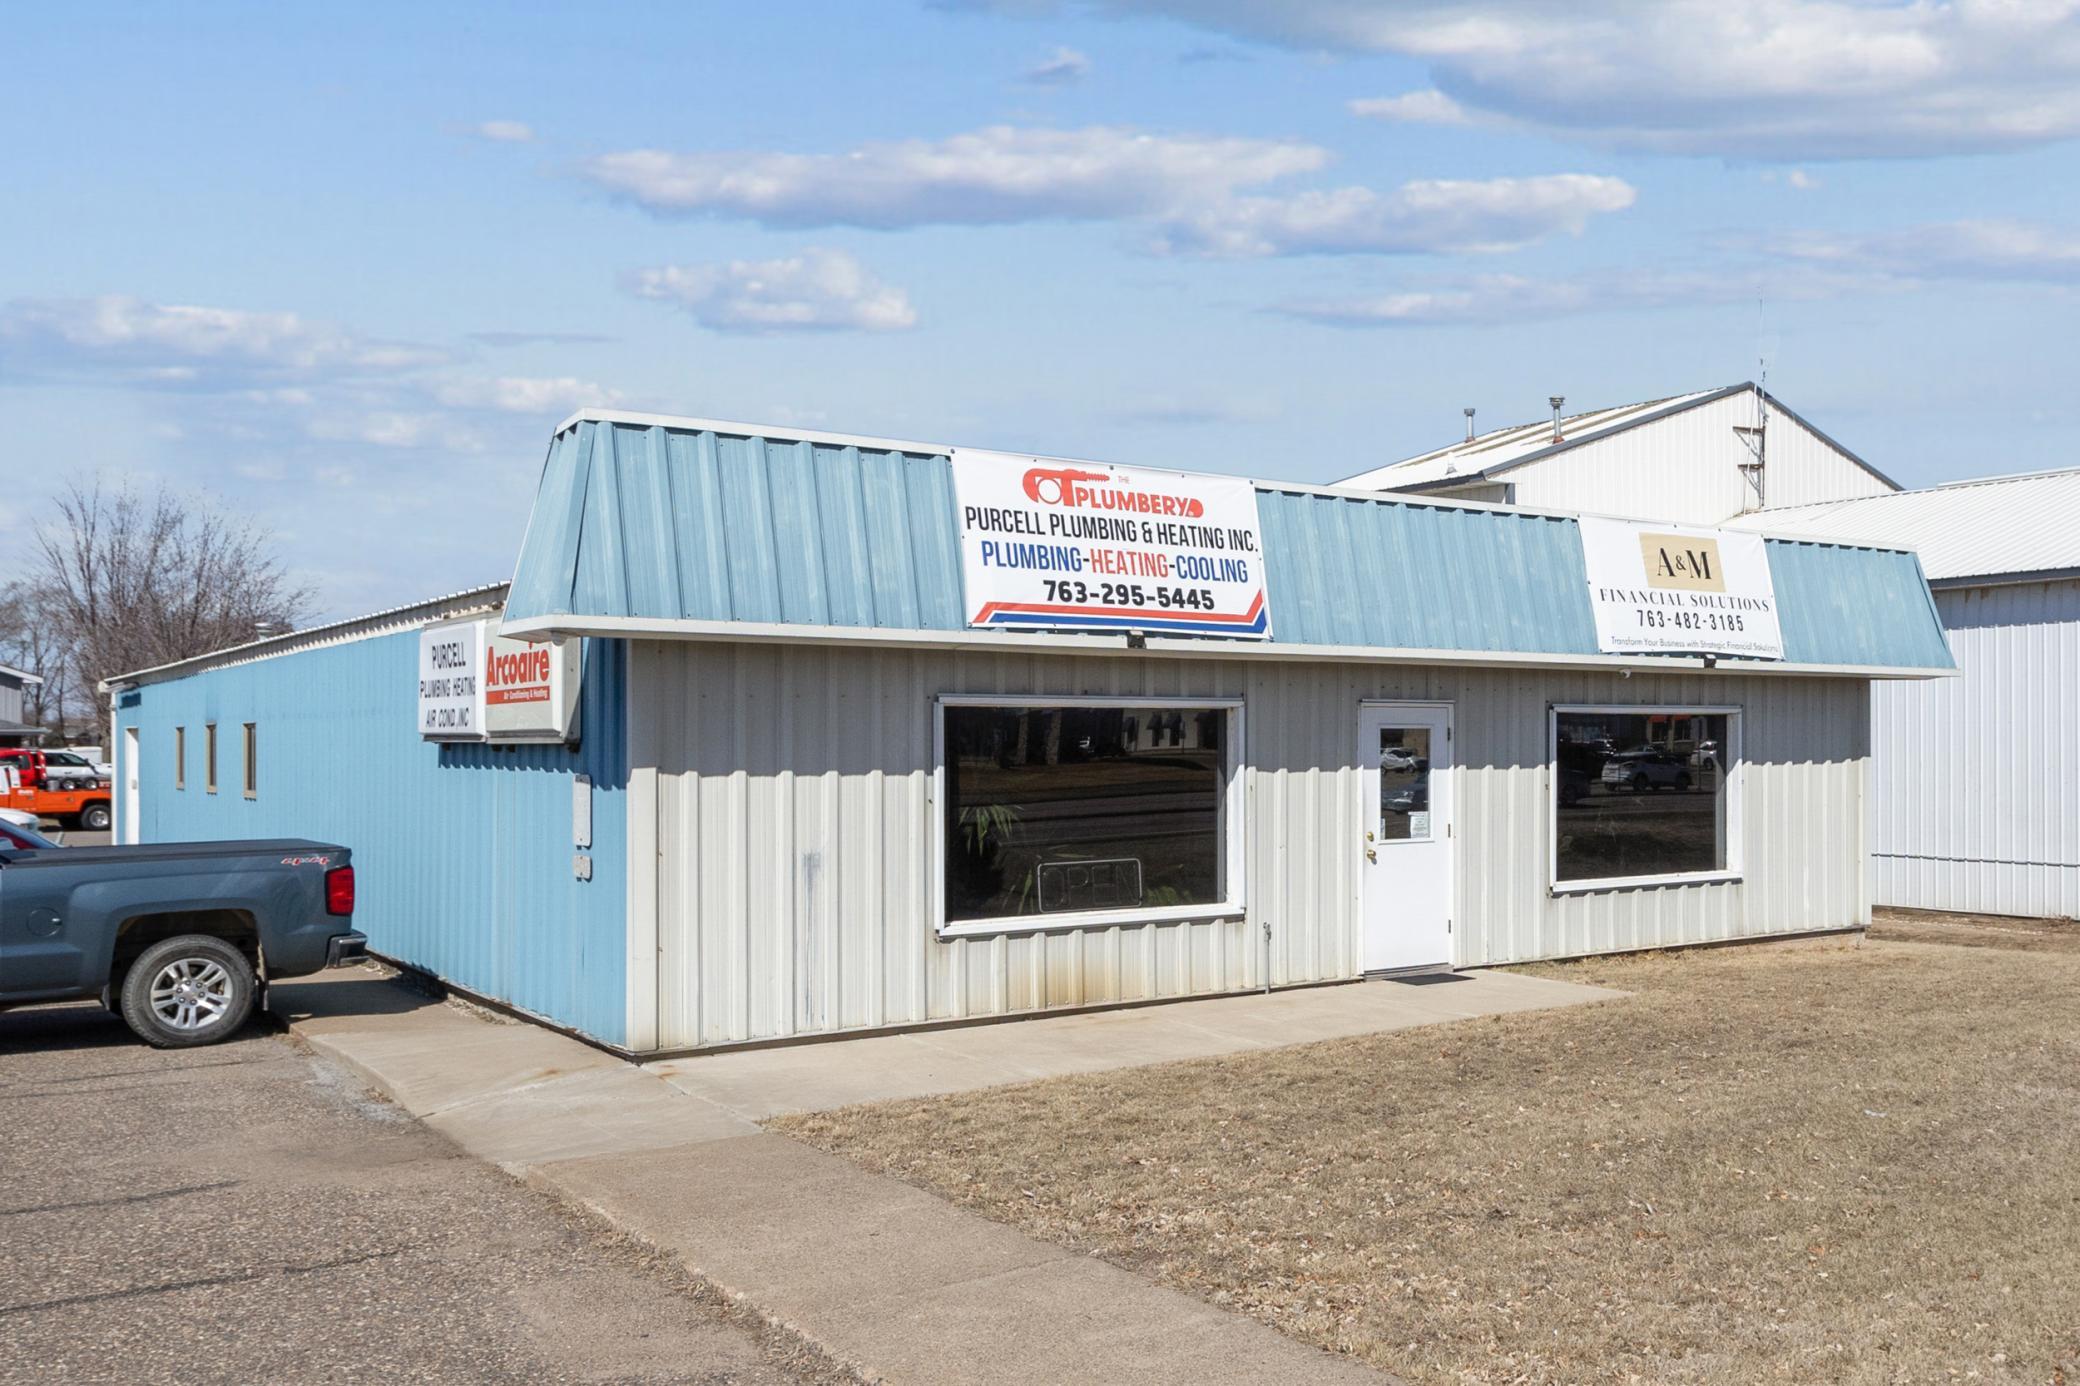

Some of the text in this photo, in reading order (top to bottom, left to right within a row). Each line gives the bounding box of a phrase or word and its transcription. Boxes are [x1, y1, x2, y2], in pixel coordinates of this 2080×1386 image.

[1118, 475, 1130, 484] THE
[965, 506, 1258, 552] PURCELL PLUMBING & HEATING INC.
[981, 540, 1248, 583] PLUMBING-HEATING-COOLING
[1657, 547, 1712, 579] A&M
[1043, 579, 1215, 610] 763-295-5445
[1600, 588, 1770, 612] FINANCIAL SOLUTIONS
[1637, 610, 1744, 631] 763-482-3185
[432, 642, 466, 669] PURCELL
[1611, 636, 1643, 646] Transform
[1644, 638, 1658, 647] Your
[1659, 638, 1685, 647] Business
[1687, 639, 1700, 648] with
[1700, 640, 1726, 650] Strategic
[1727, 641, 1752, 650] Financial
[487, 640, 550, 686] Arcoaire
[420, 679, 451, 698] PLUMBING
[426, 709, 436, 728] AIR
[1042, 864, 1138, 908] OPEN
